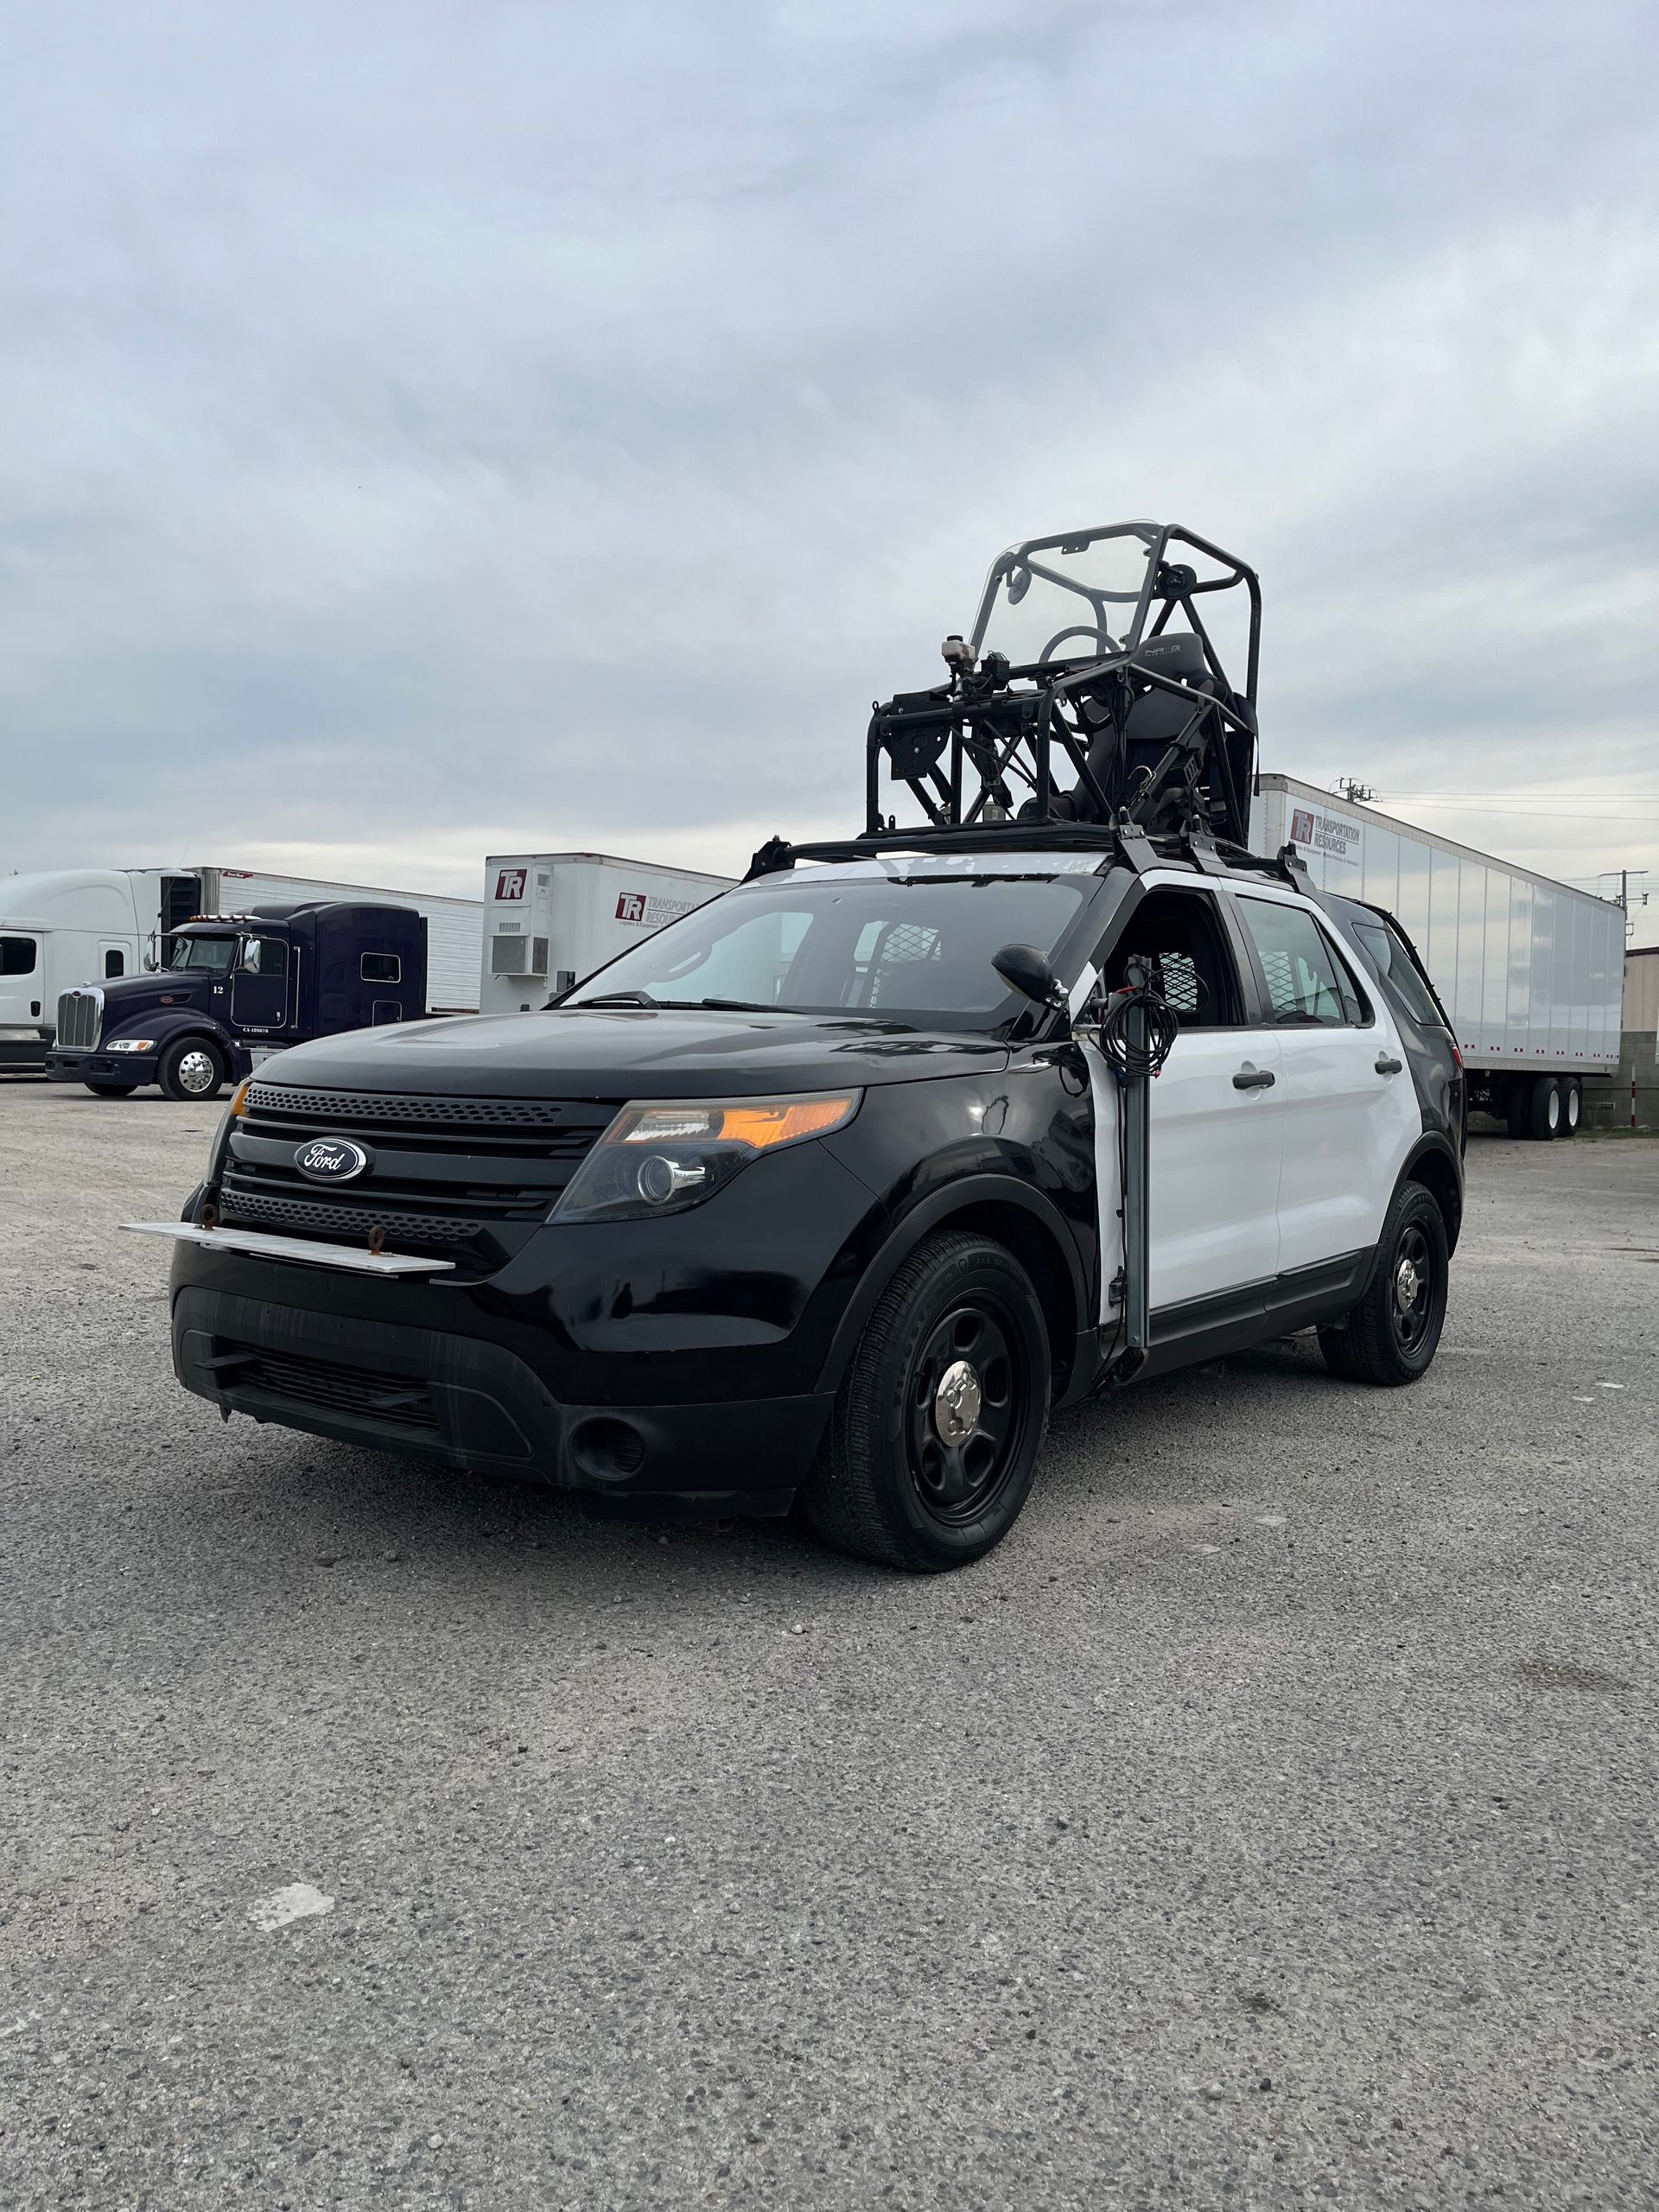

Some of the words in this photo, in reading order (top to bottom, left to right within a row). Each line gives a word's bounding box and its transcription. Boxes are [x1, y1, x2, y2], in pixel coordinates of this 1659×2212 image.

[1315, 815, 1360, 842] TRANSPORTATION
[1314, 832, 1346, 855] RESOURCES
[501, 871, 523, 898] TR
[620, 893, 642, 919] TR
[304, 1144, 345, 1170] Ford
